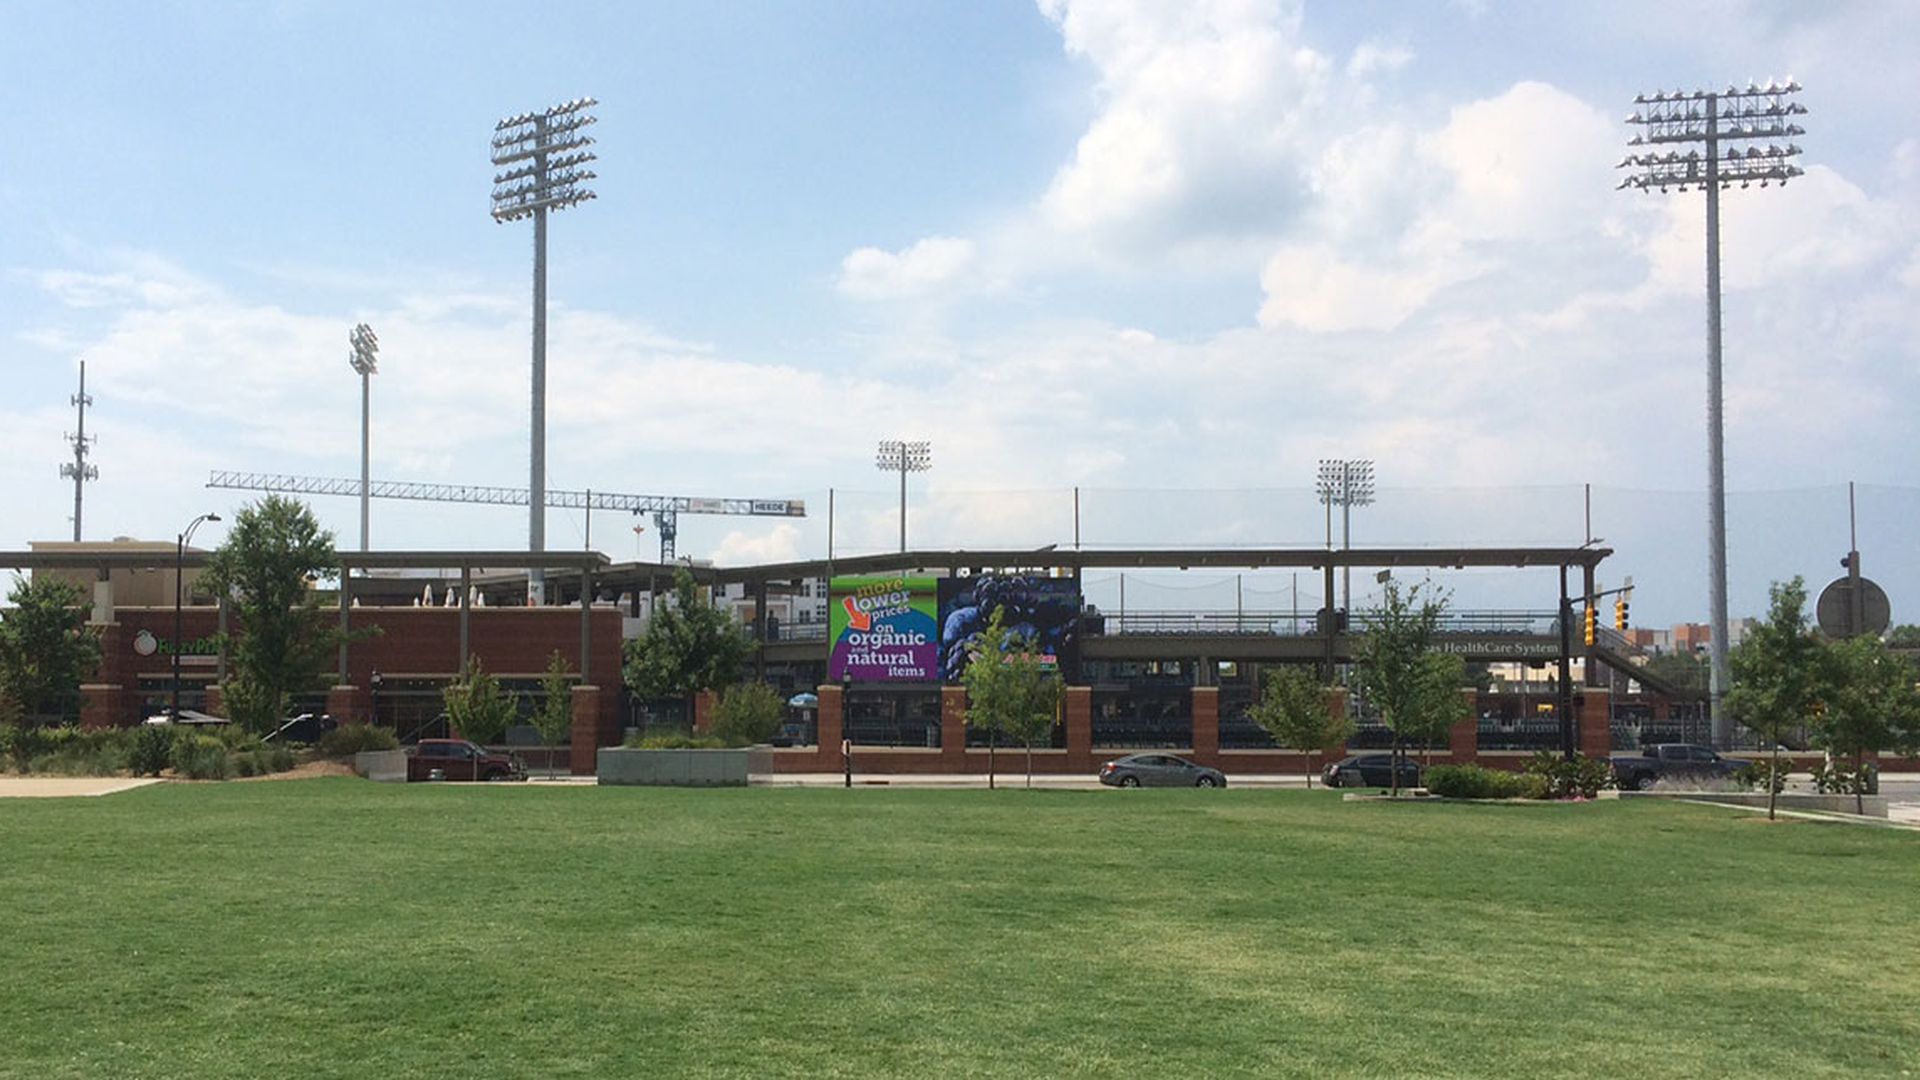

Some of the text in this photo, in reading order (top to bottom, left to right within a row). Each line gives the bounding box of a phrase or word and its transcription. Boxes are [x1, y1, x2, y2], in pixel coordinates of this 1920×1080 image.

[755, 503, 784, 511] HEEDE
[857, 579, 903, 596] more
[852, 590, 911, 611] lower
[872, 605, 910, 622] prices
[875, 624, 894, 633] on
[848, 629, 926, 649] organic
[1444, 641, 1513, 653] HealthCare
[1514, 642, 1559, 655] System
[847, 651, 914, 665] natural
[888, 666, 925, 677] items
